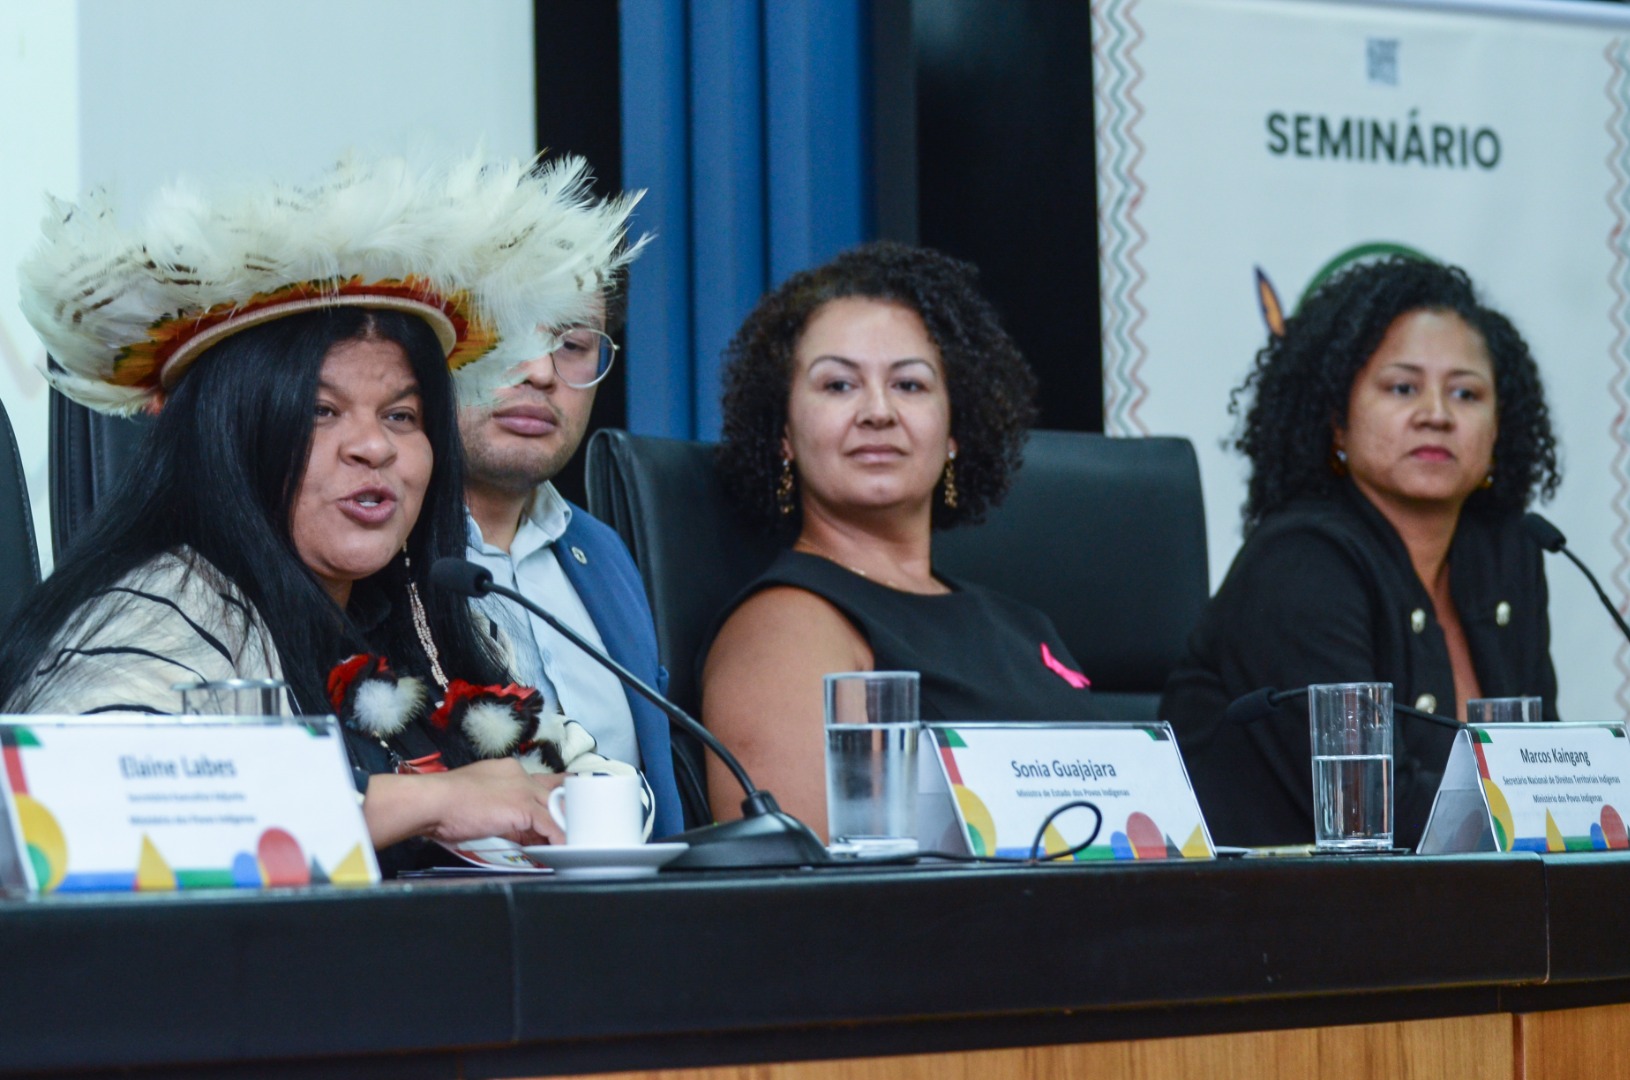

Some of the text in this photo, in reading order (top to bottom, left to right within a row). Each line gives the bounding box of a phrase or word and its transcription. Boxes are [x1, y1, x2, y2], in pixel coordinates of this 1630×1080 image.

[1266, 107, 1503, 170] SEMINÁRIO
[1519, 747, 1591, 767] Marcos Kaingang
[1011, 759, 1117, 781] Sonia Guajajara
